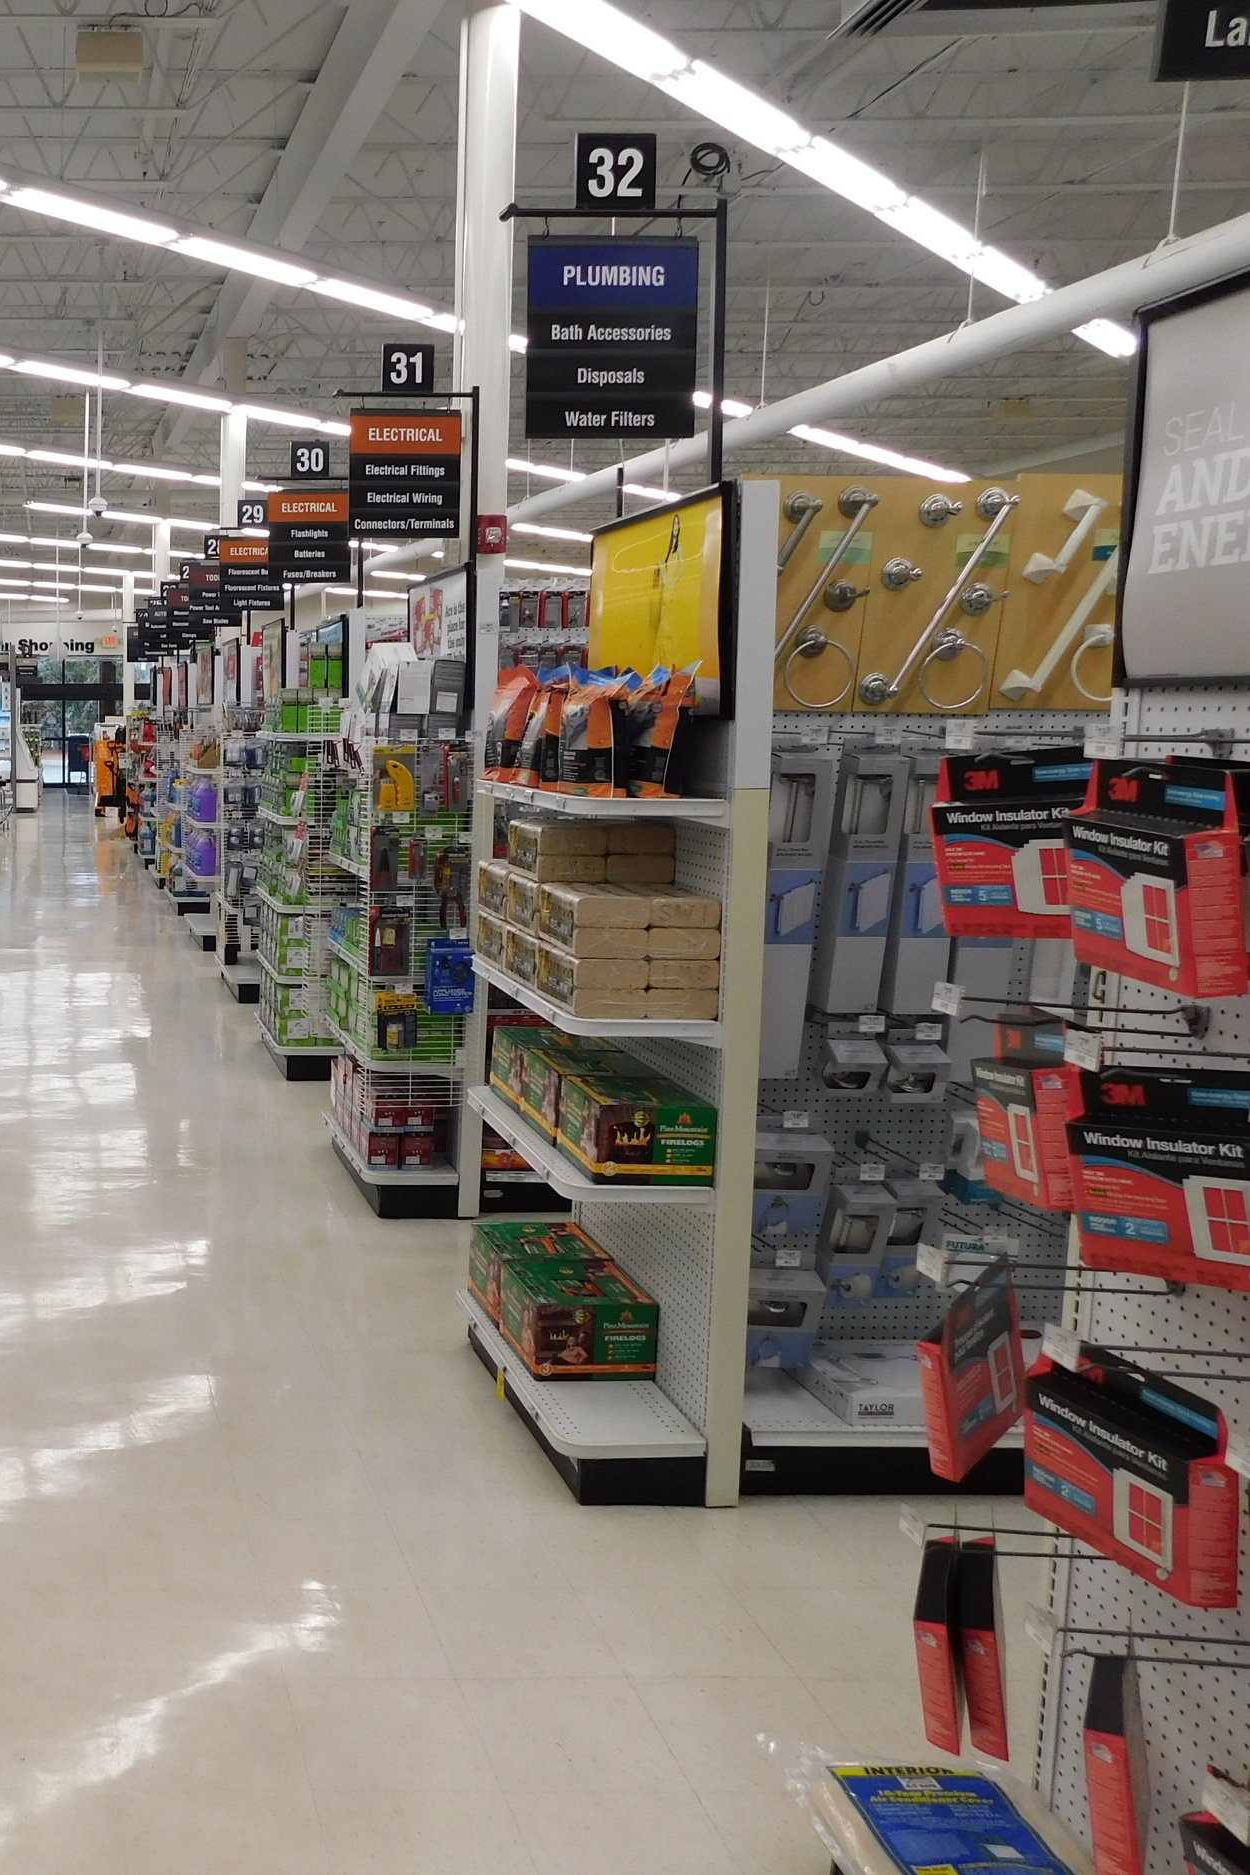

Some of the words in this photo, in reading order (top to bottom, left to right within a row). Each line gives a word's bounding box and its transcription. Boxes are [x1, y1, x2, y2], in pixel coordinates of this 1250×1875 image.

[1205, 10, 1250, 47] La
[588, 148, 644, 197] 32
[563, 265, 664, 286] PLUMBING
[551, 324, 582, 340] Bath
[587, 324, 671, 341] Accessories
[390, 352, 422, 384] 31
[577, 368, 644, 387] Disposals
[565, 410, 607, 427] Water
[611, 410, 655, 427] Filters
[368, 427, 443, 442] ELECTRICAL
[1163, 402, 1243, 456] SEAL
[296, 448, 323, 472] 30
[365, 464, 407, 475] Electrical
[411, 465, 445, 478] Fittings
[1155, 448, 1250, 516] AND
[367, 492, 409, 503] Electrical
[412, 493, 442, 505] Wiring
[242, 505, 264, 523] 29
[281, 502, 337, 513] ELECTRICAL
[354, 518, 454, 530] Connectors/Terminals
[291, 529, 328, 539] Flashlights
[1148, 510, 1250, 574] ENE
[294, 550, 325, 558] Batteries
[283, 570, 336, 579] Fuses/Breakers
[224, 584, 254, 592] Fluorescent
[256, 584, 279, 592] Fixtures
[233, 599, 248, 607] Light
[250, 599, 270, 607] Fixtures
[964, 771, 998, 791] 3M
[1108, 777, 1139, 802] 3M
[946, 812, 992, 824] Window
[995, 809, 1049, 823] Insulator
[1051, 806, 1070, 819] Kit
[1072, 826, 1109, 845] Window
[1109, 833, 1152, 853] Insulator
[1153, 842, 1169, 856] Kit
[978, 891, 986, 901] 5
[1101, 1082, 1146, 1106] 3M
[1083, 1131, 1142, 1149] Window
[1146, 1137, 1215, 1156] Insulator
[1218, 1143, 1244, 1158] Kit
[1128, 1150, 1140, 1159] Kit
[1178, 1155, 1200, 1165] para
[1201, 1157, 1245, 1168] Ventanas
[1125, 1222, 1137, 1235] 2
[946, 1240, 985, 1250] FUTURA
[858, 1403, 894, 1412] TAYLOR
[1039, 1393, 1087, 1430] Window
[1088, 1419, 1145, 1459] Insulator
[1147, 1448, 1168, 1472] Kit
[1061, 1484, 1070, 1497] 2
[864, 1766, 955, 1775] INTERIOR
